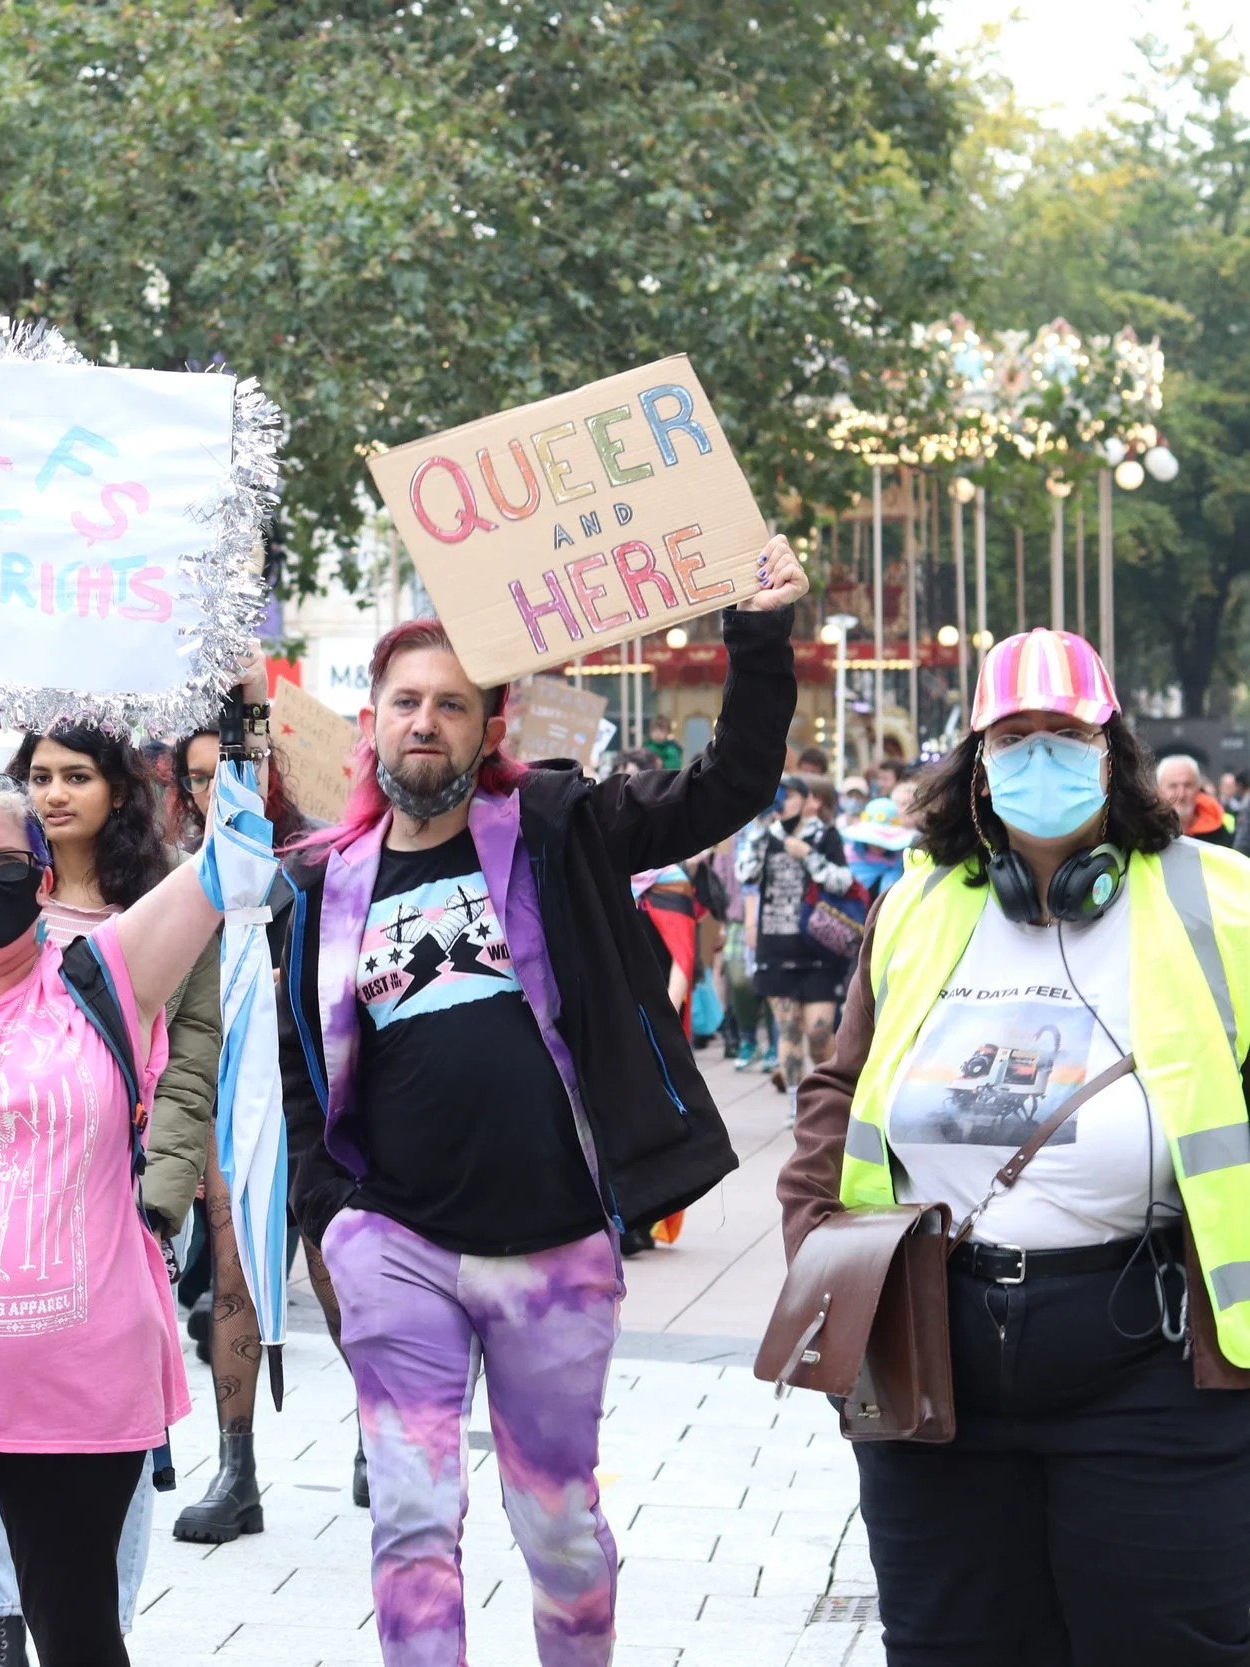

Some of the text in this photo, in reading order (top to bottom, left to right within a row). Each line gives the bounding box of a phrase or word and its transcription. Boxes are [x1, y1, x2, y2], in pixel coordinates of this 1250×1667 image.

[409, 384, 713, 544] QUEER
[554, 503, 633, 550] AND
[0, 551, 173, 623] RIGHTS
[508, 524, 735, 654] HERE
[361, 971, 399, 1002] BEST IN
[938, 987, 973, 1000] RAW
[976, 988, 1019, 1001] DATA
[1024, 985, 1073, 1001] FEEL
[8, 1294, 70, 1317] APPAREL
